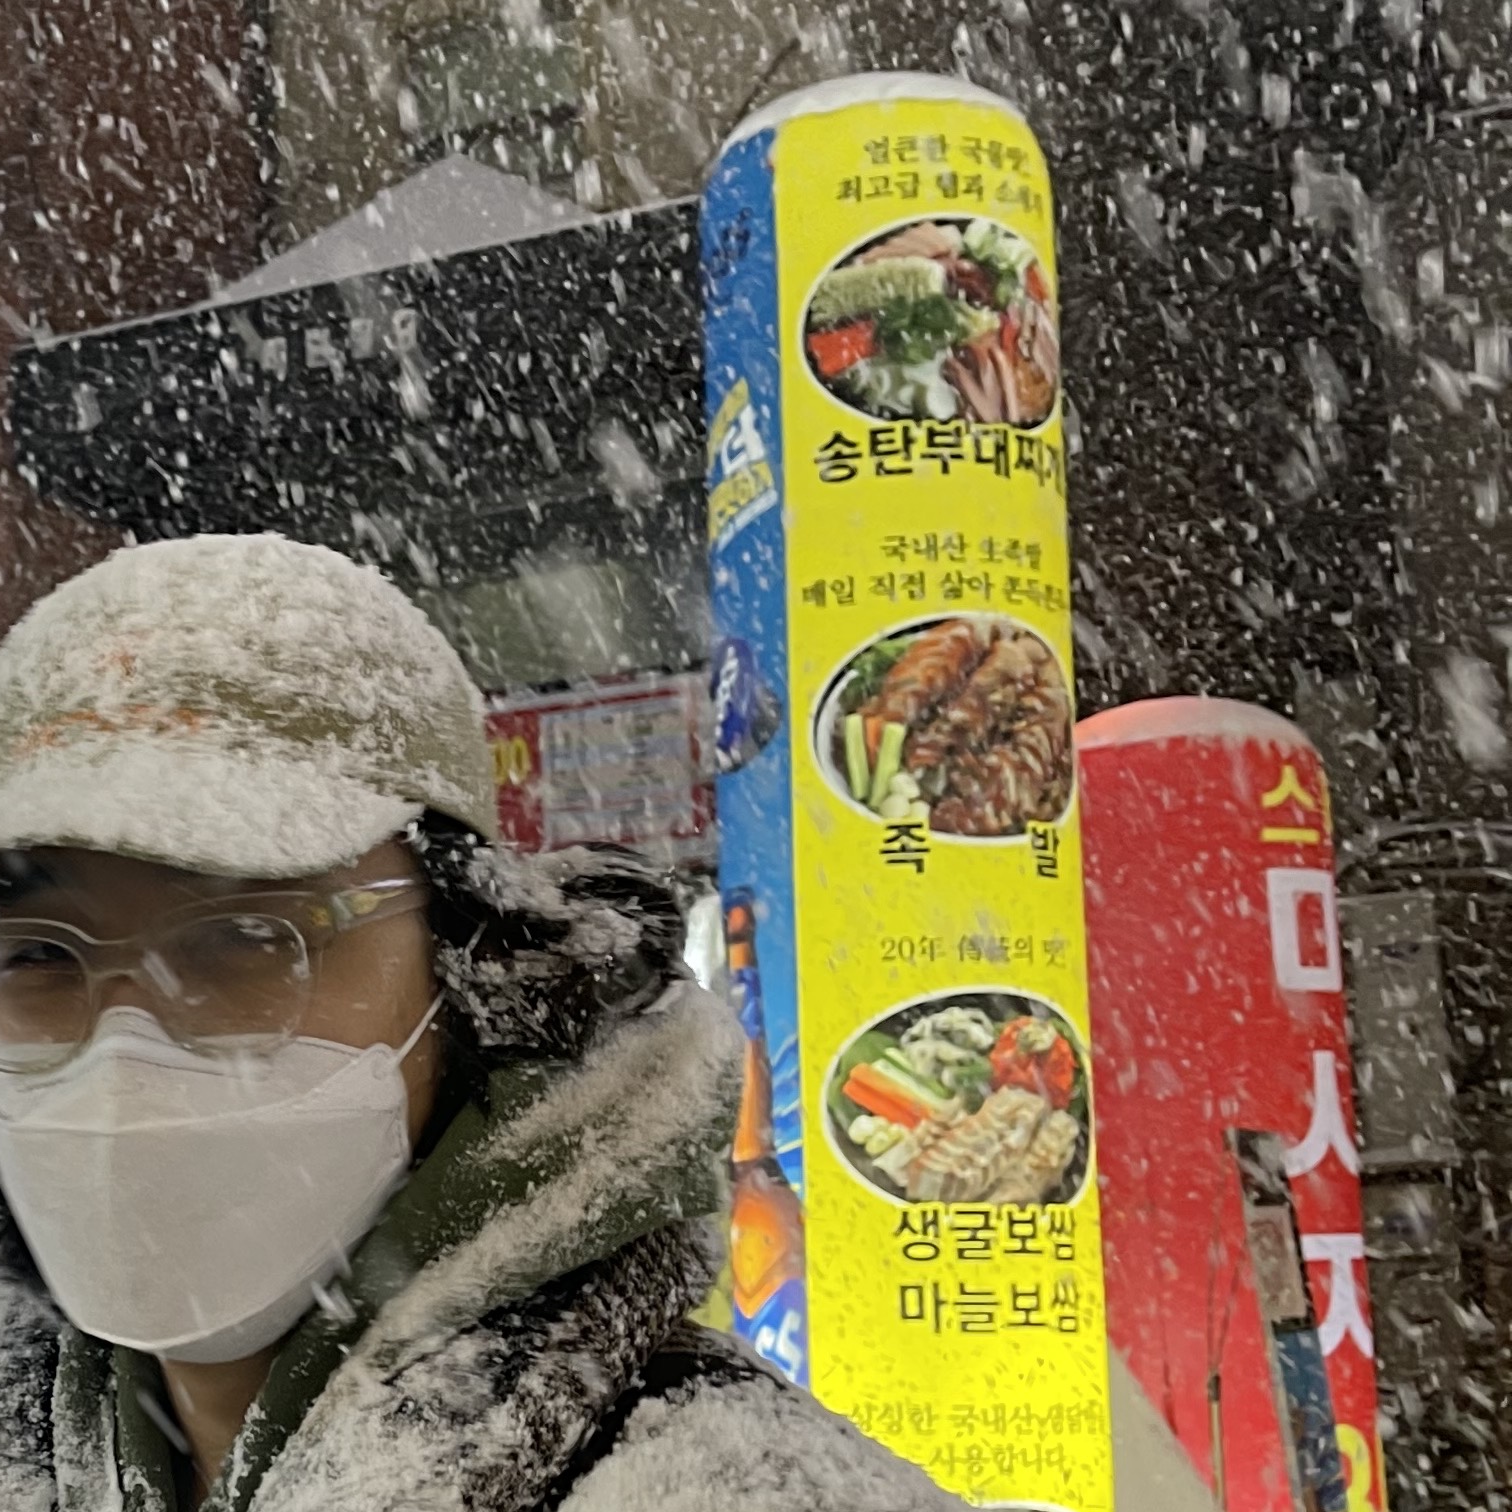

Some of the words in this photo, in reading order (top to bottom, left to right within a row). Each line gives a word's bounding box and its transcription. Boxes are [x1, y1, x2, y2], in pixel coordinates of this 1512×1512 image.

[835, 172, 920, 202] 최고급
[880, 532, 968, 564] 국내산
[868, 570, 926, 603] 직접
[879, 822, 931, 874] 족
[893, 1206, 1078, 1263] 생굴보쌈
[899, 1280, 1080, 1336] 마늘보쌈
[929, 1443, 1068, 1476] 사용합니다
